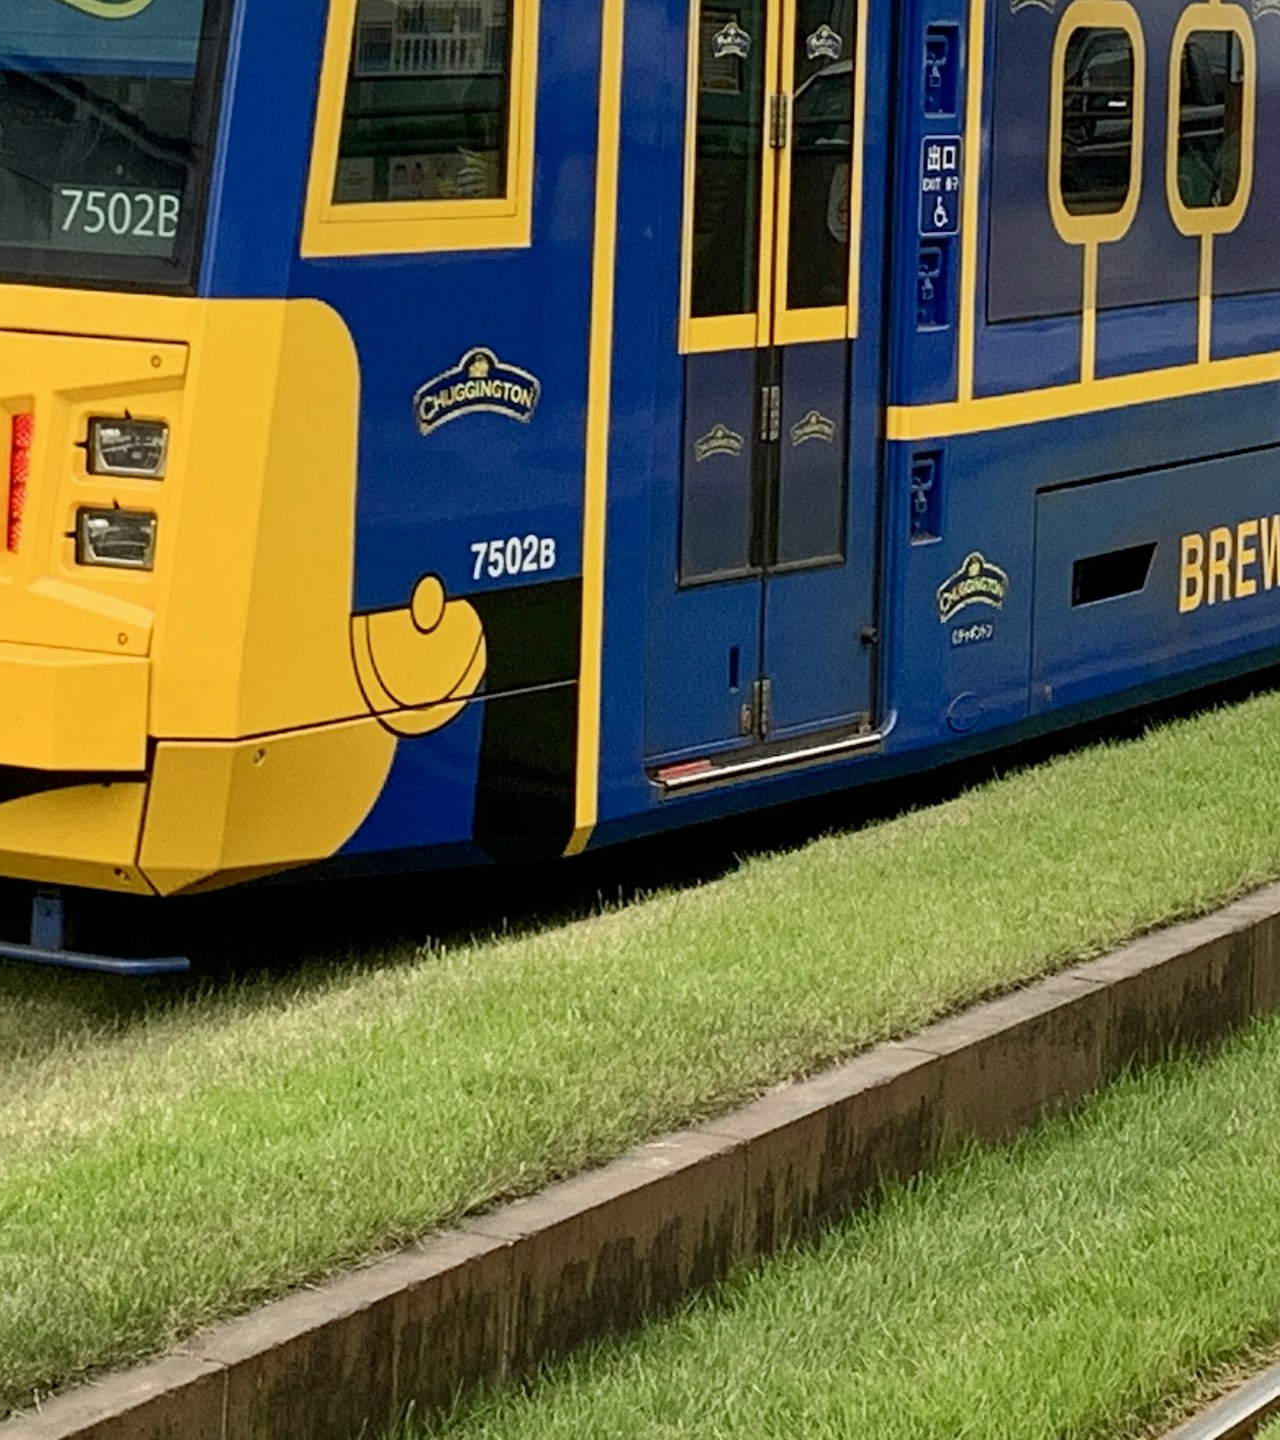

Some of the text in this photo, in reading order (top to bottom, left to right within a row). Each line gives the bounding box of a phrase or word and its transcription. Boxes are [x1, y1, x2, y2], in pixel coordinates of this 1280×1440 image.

[926, 145, 957, 172] 出口
[60, 188, 180, 238] 7502B
[421, 378, 534, 421] CHUGGINGTON
[470, 533, 556, 580] 7502B
